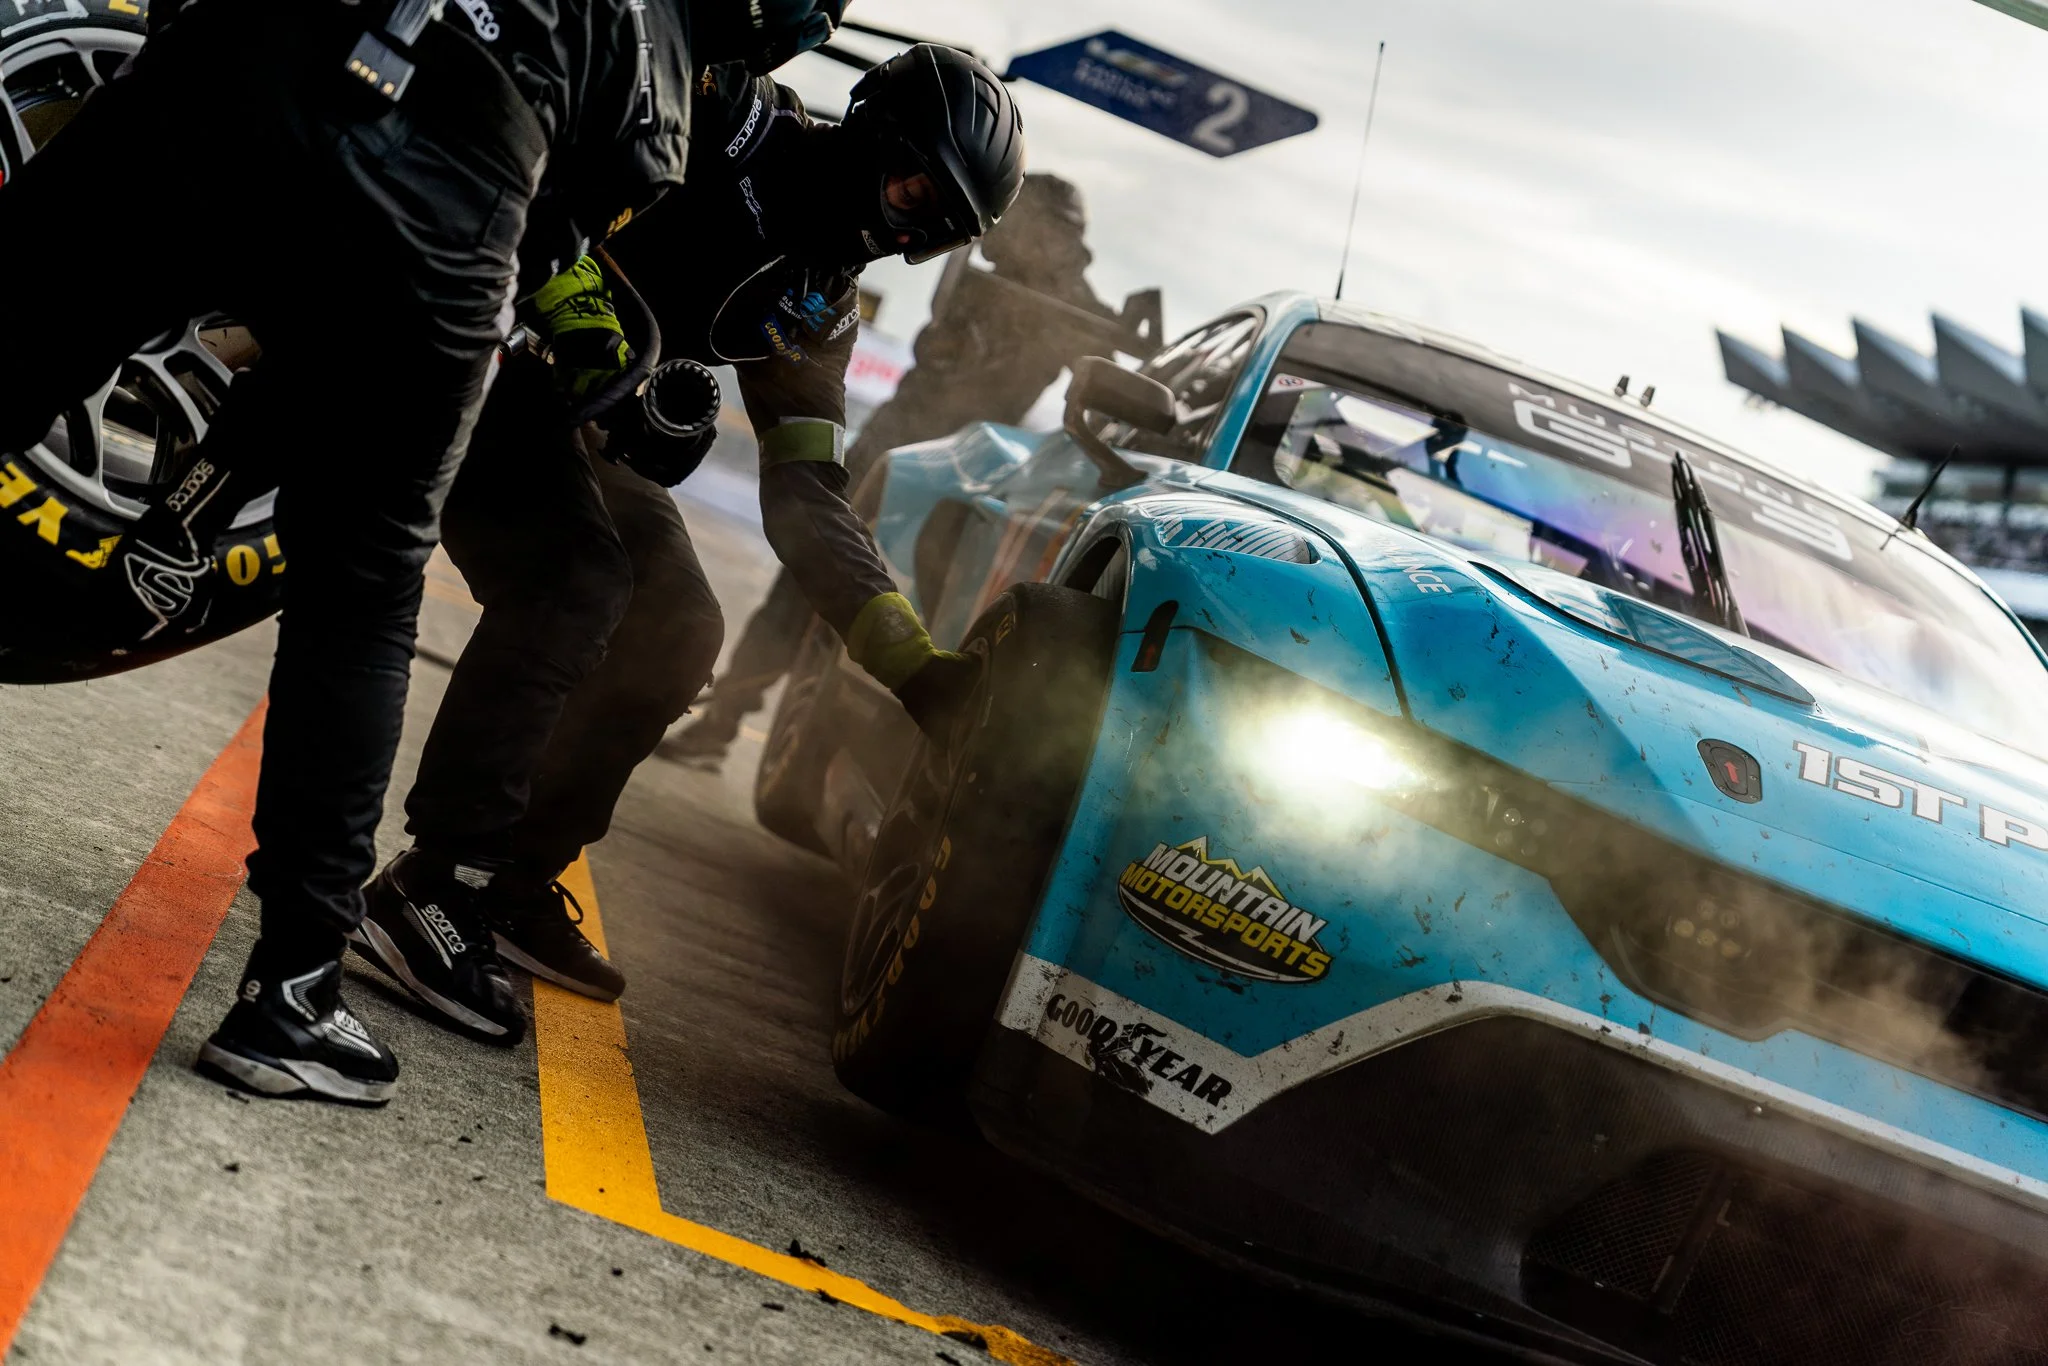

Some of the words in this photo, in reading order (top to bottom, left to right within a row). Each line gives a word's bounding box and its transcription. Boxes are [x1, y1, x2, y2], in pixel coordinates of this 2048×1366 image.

[725, 97, 763, 158] sparco
[1191, 82, 1249, 151] 2
[166, 457, 215, 512] sparco
[1508, 382, 1841, 527] MUSTANG
[1793, 739, 1968, 825] 1ST
[420, 903, 467, 955] sparco
[1119, 862, 1332, 978] MOTORSPORTS
[1143, 842, 1328, 944] MOUNTAIN
[831, 834, 954, 1064] GOODY
[1047, 993, 1232, 1107] GOODYEAR
